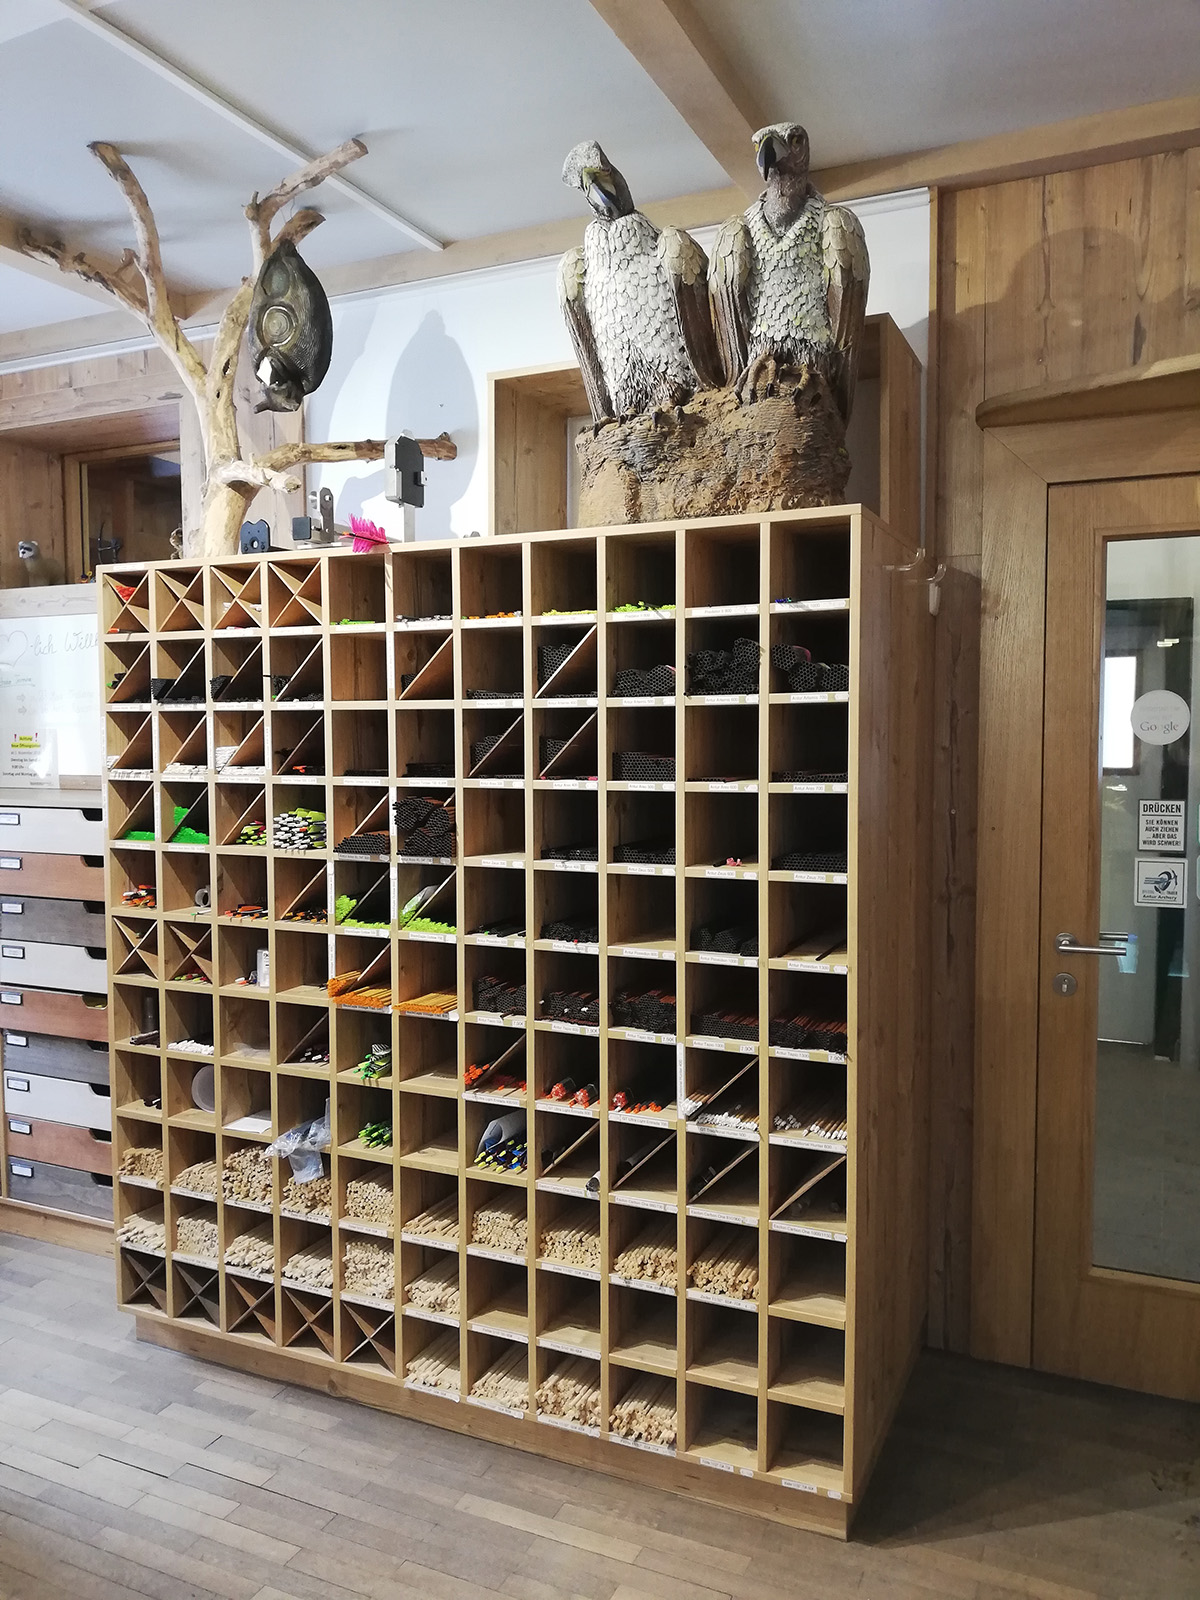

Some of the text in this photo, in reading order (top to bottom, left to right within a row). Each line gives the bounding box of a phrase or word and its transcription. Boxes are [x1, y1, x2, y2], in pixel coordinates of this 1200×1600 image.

[1140, 721, 1179, 734] Gogle
[1143, 802, 1181, 813] DRÜCKEN
[1156, 818, 1179, 826] KÖNNEN
